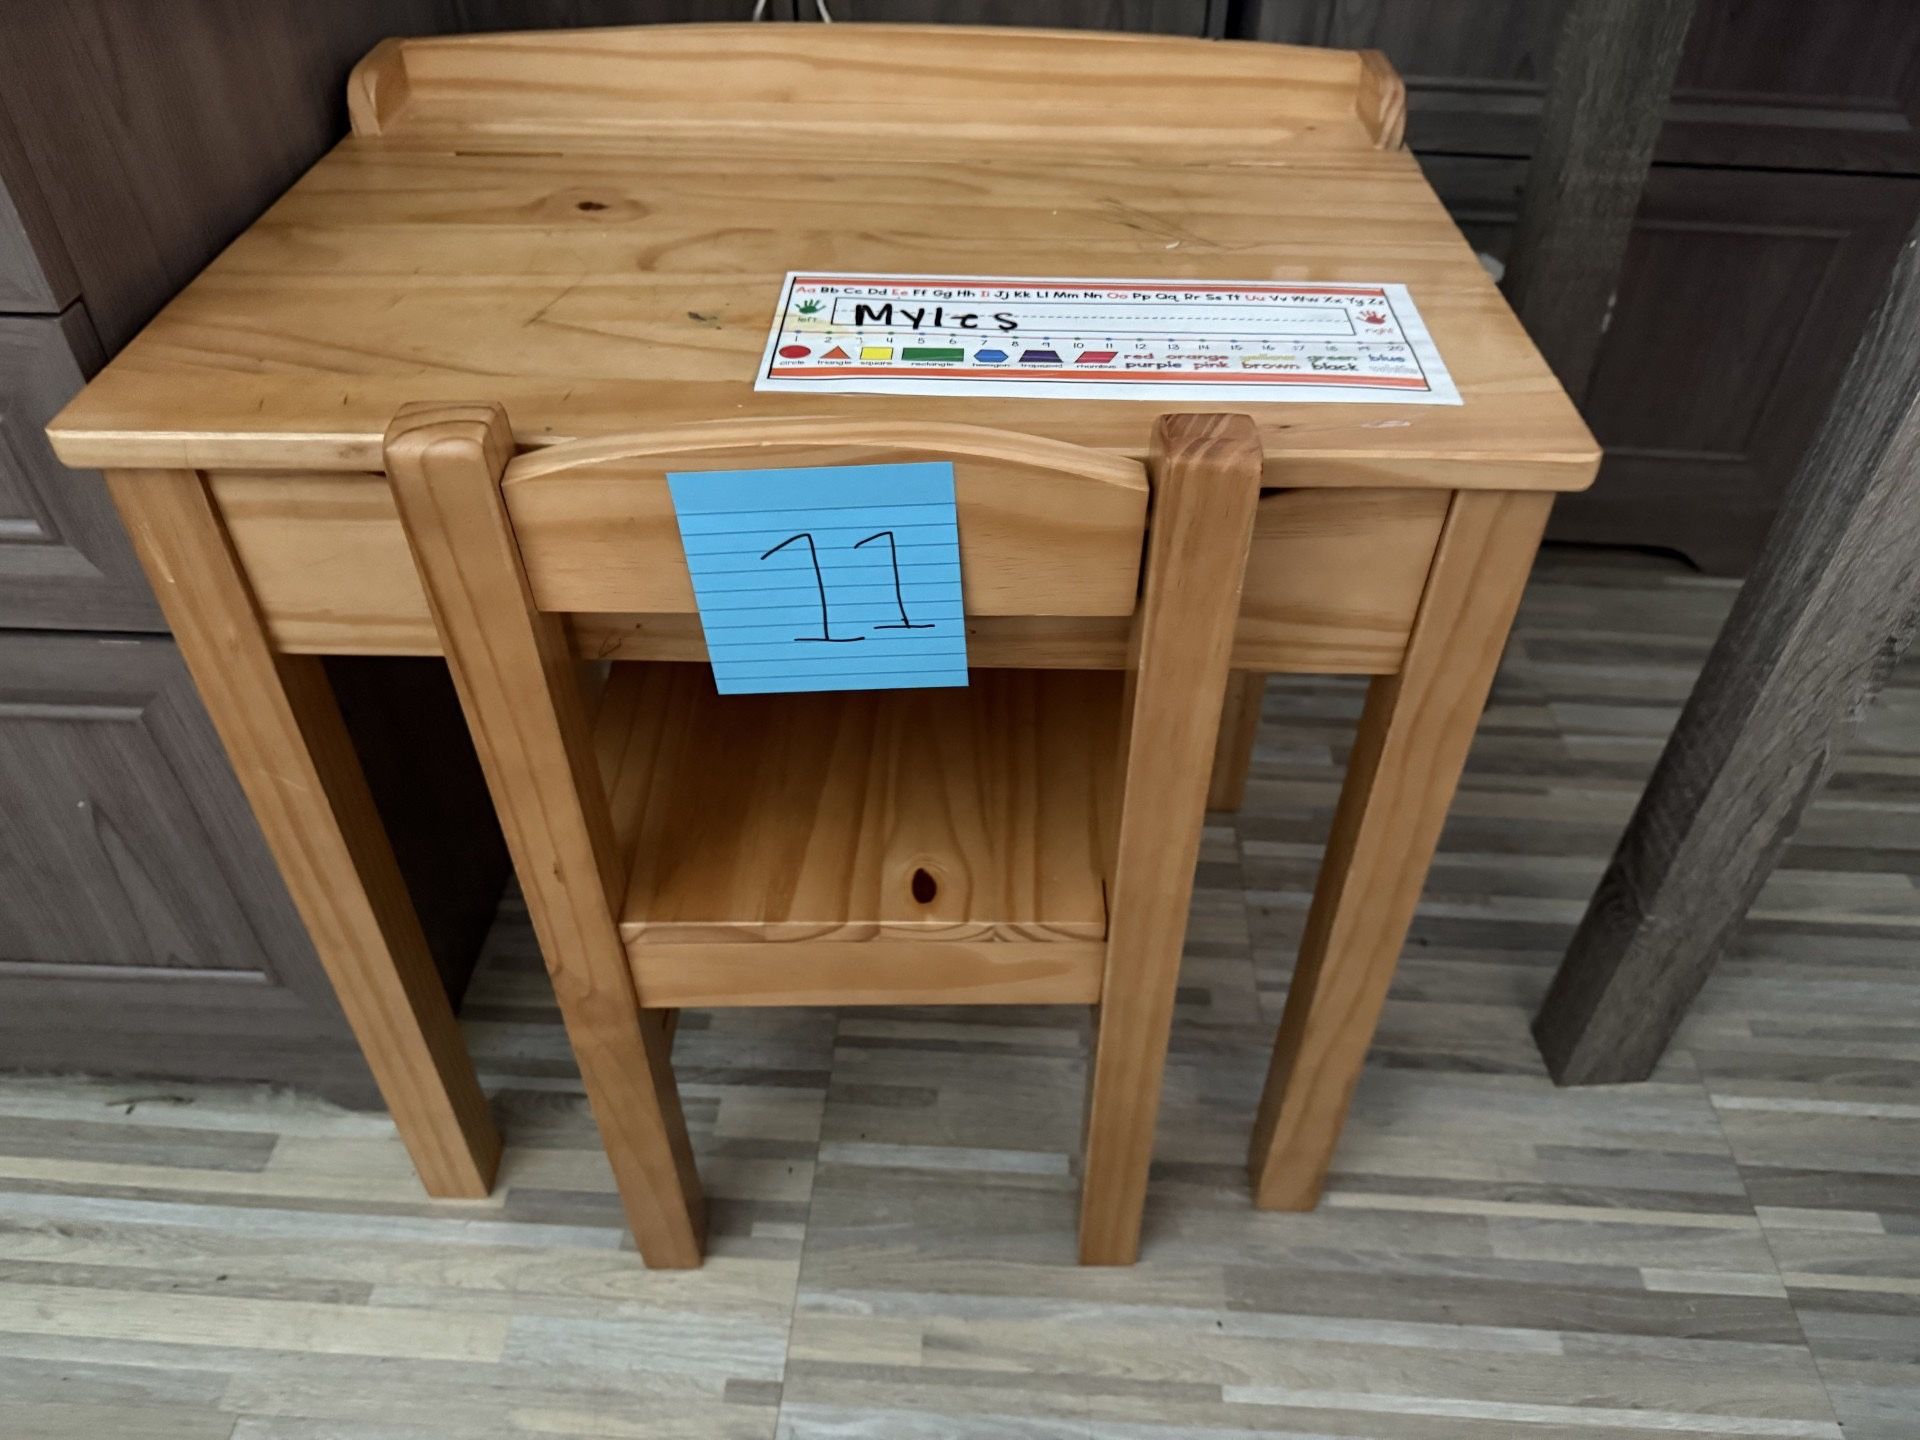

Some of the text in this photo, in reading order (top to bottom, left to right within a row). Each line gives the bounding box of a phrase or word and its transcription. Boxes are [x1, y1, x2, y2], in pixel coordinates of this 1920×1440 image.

[820, 286, 839, 294] Bb
[843, 287, 863, 295] Cc
[868, 288, 887, 296] Dd
[933, 290, 952, 299] Gg
[981, 290, 990, 298] Ii
[994, 291, 1009, 300] Jj
[1053, 291, 1079, 299] Mm
[1132, 292, 1151, 301] Pp
[1155, 293, 1180, 302] Qq
[1206, 293, 1222, 301] Ss
[1245, 294, 1266, 302] Uu
[1323, 296, 1343, 304] Xx
[1346, 297, 1364, 306] Yy
[1368, 298, 1384, 306] Zz
[1125, 361, 1182, 370] purple
[1193, 361, 1231, 370] pink
[1241, 360, 1301, 370] brown
[1311, 361, 1358, 371] black
[1165, 354, 1229, 362] orange
[1368, 354, 1405, 362] blue
[760, 531, 935, 641] 11
